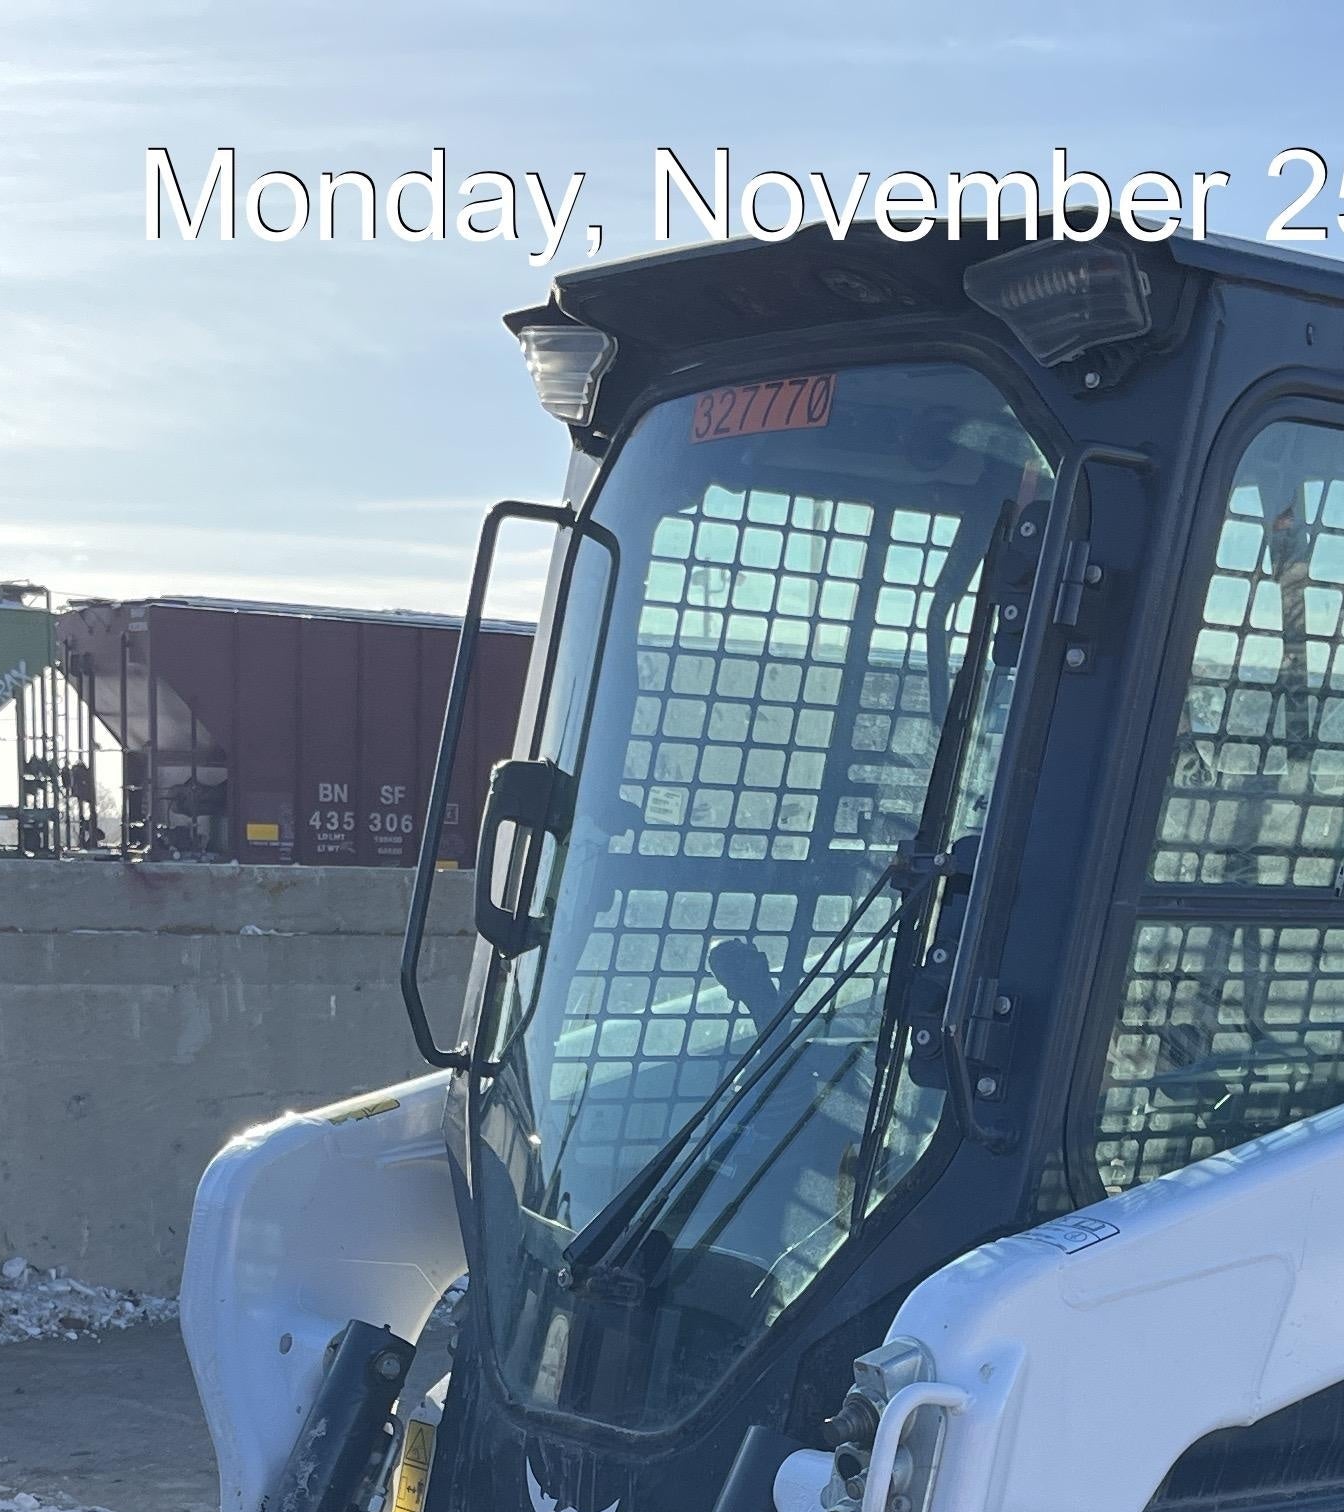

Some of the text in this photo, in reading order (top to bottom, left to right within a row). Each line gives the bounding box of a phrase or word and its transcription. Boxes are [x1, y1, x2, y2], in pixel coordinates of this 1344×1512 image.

[695, 375, 832, 438] 327770
[319, 783, 406, 805] BN SF
[308, 810, 413, 833] 435 306
